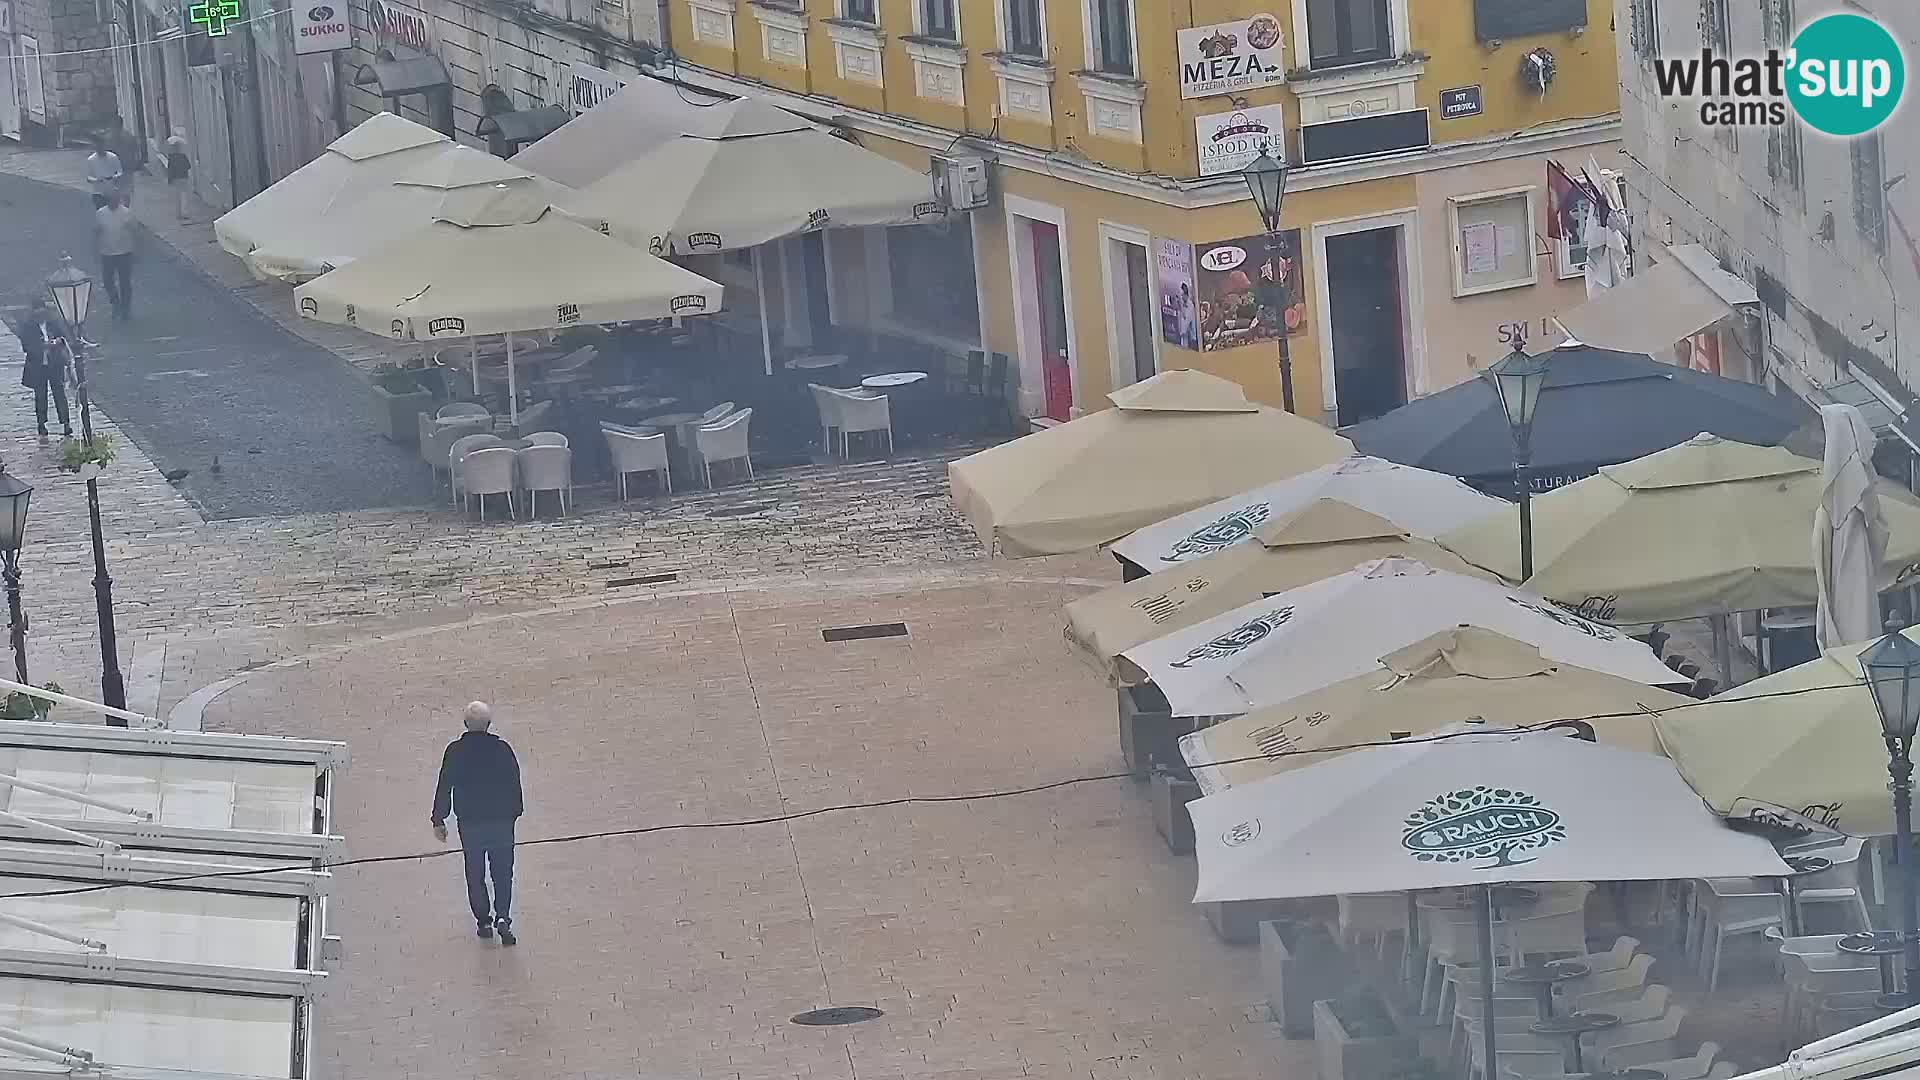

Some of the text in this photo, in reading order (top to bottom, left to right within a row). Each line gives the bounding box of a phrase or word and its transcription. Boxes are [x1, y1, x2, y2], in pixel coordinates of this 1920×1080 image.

[300, 23, 345, 37] SUKNO
[1184, 54, 1263, 84] MEZA
[1193, 81, 1226, 92] PIZZERIA
[1202, 139, 1248, 157] ISPOD
[1442, 812, 1541, 842] RAUCH
